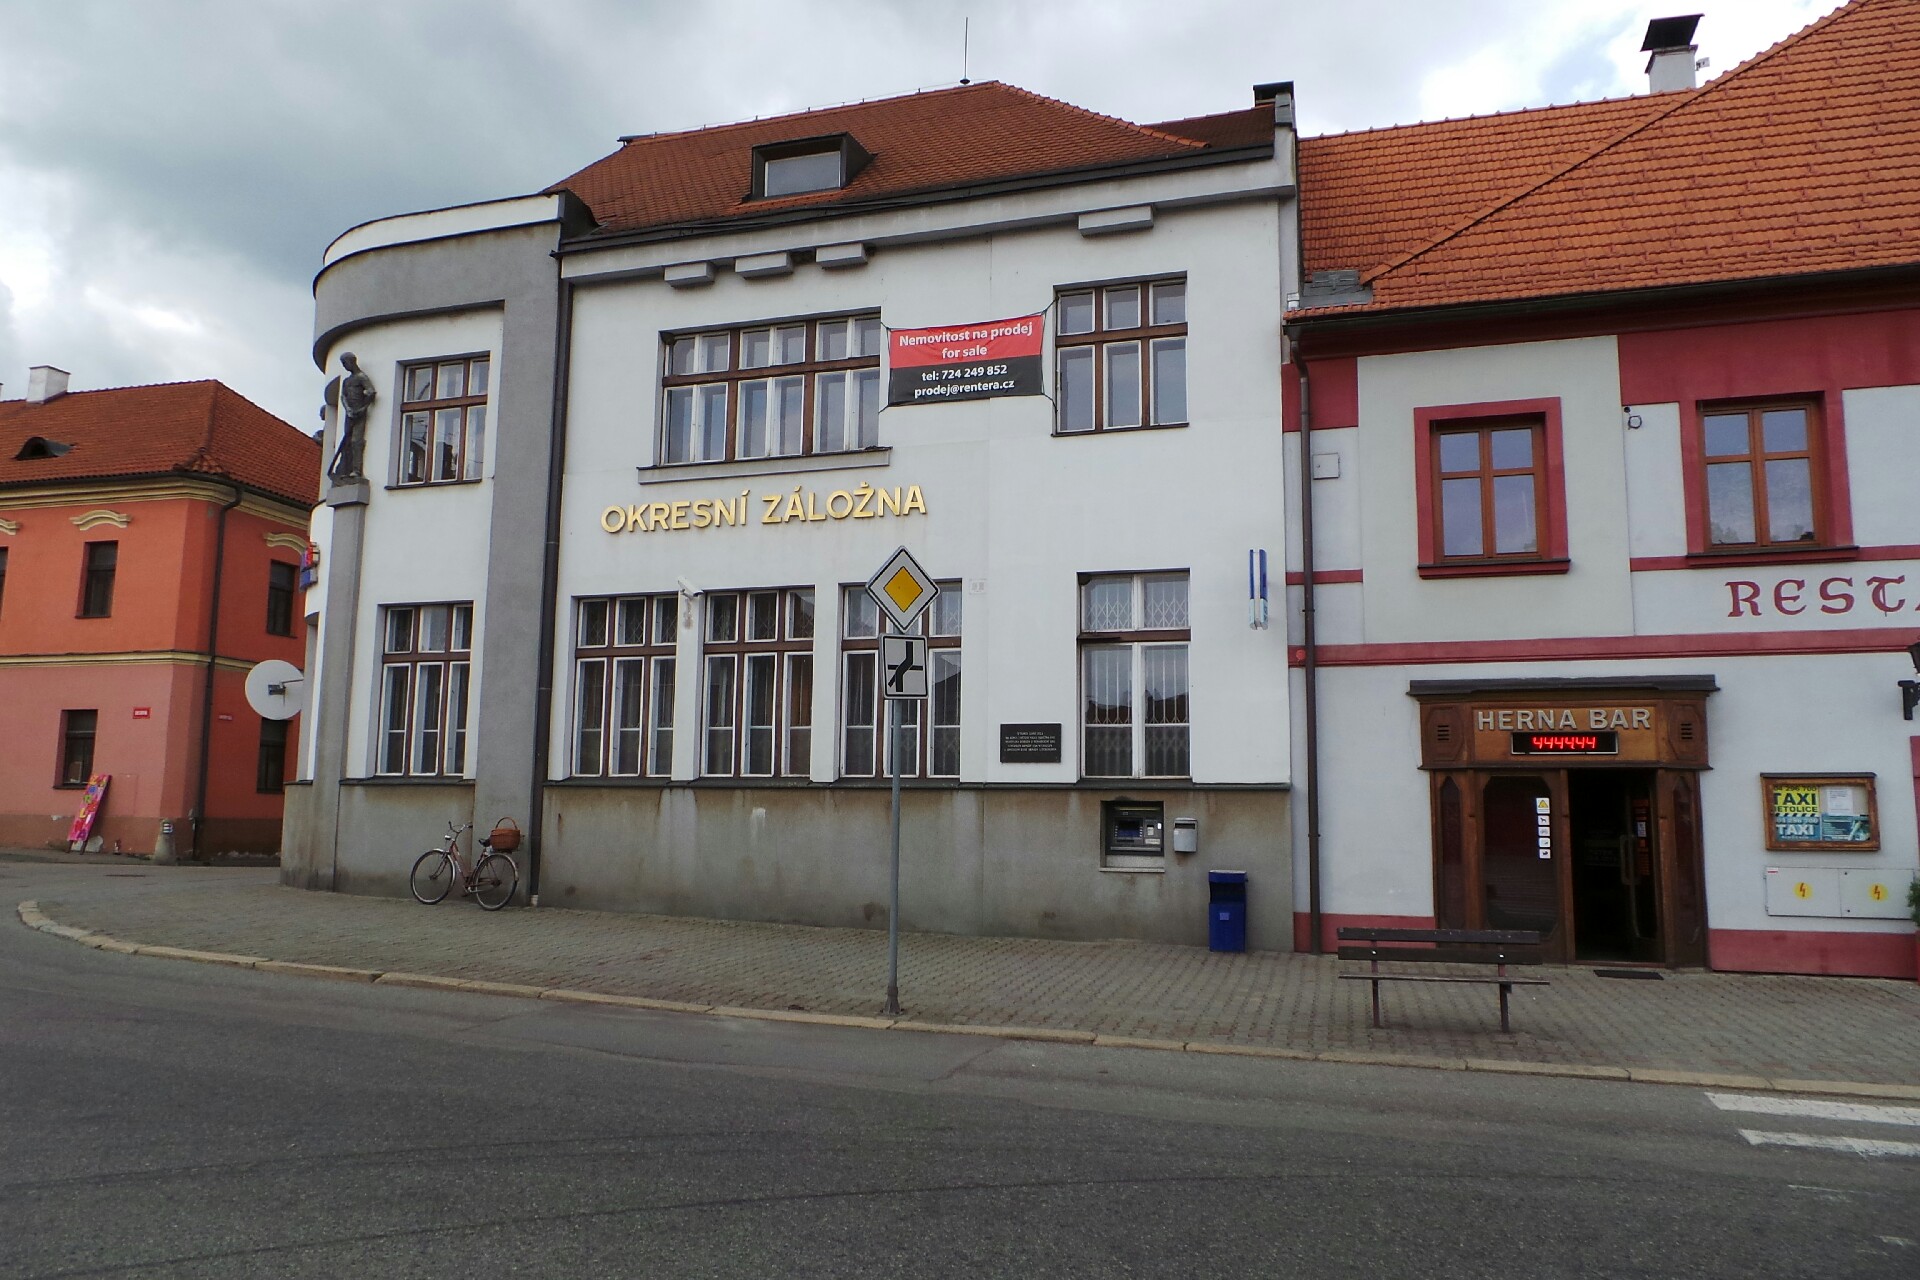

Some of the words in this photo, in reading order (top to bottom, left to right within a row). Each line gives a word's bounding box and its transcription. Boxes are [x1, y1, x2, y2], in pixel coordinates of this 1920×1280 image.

[899, 331, 970, 347] Nemovitost
[972, 328, 988, 339] na
[991, 322, 1033, 341] prodej
[942, 347, 961, 359] for
[963, 345, 988, 358] sale
[922, 370, 939, 381] tel:
[942, 369, 961, 380] 724
[964, 367, 984, 378] 249
[987, 365, 1008, 375] 852
[914, 379, 1015, 399] prodej@rentera.cz
[600, 489, 750, 534] OKRESNÍ
[761, 481, 927, 525] ZÁLOŽNA
[1724, 574, 1920, 618] REST
[1478, 709, 1577, 731] HERNA
[1589, 708, 1651, 729] BAR
[1774, 793, 1817, 806] TAXI
[1776, 824, 1814, 835] TAXI
